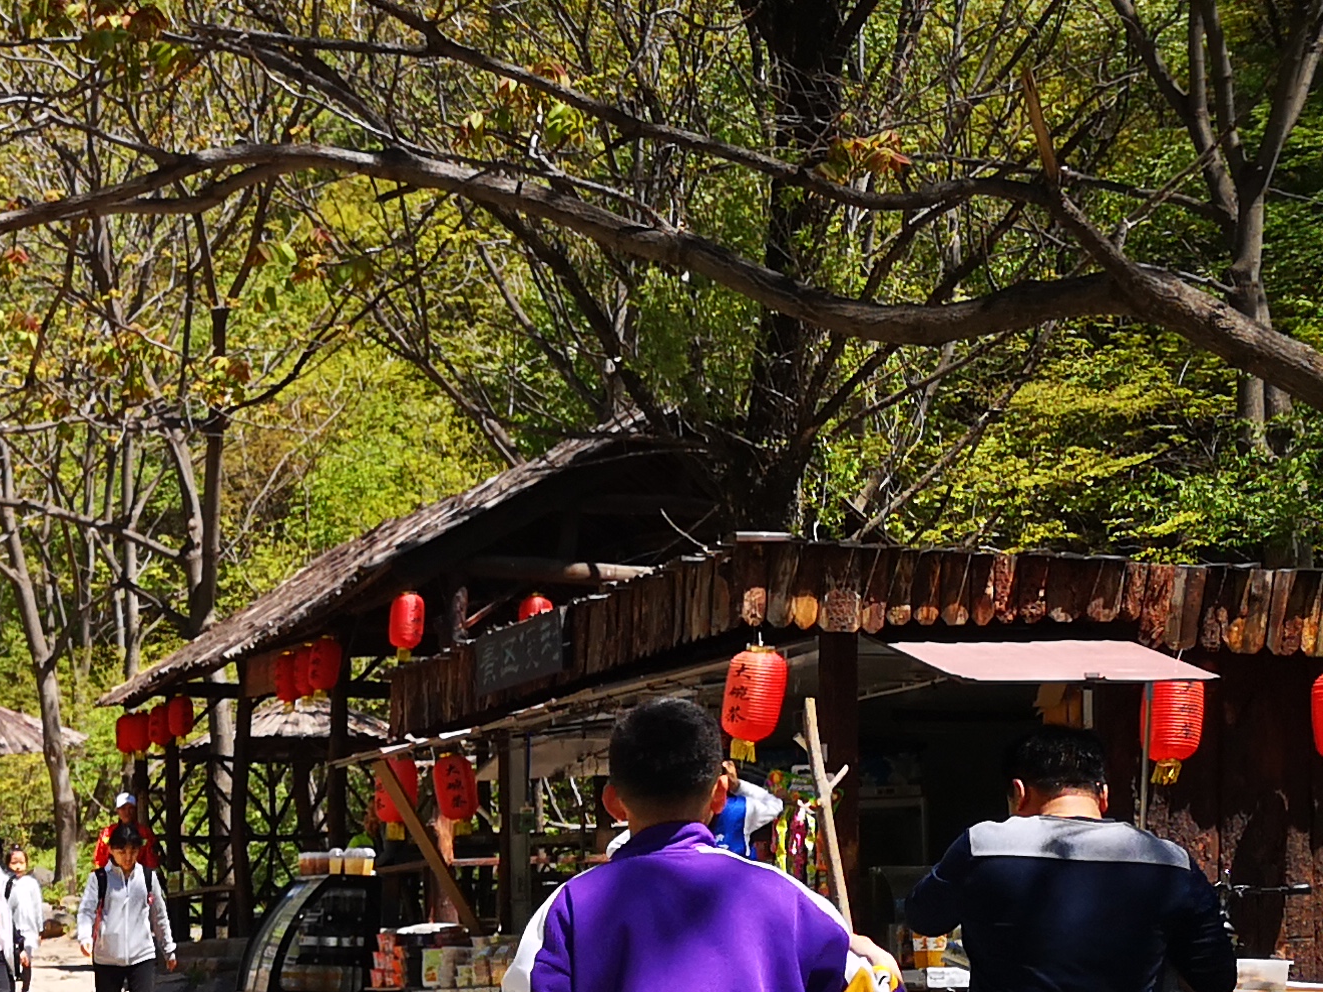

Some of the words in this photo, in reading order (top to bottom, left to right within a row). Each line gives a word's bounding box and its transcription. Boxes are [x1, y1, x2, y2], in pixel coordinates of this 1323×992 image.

[726, 662, 751, 723] 大碗茶
[446, 763, 467, 808] 大碗茶
